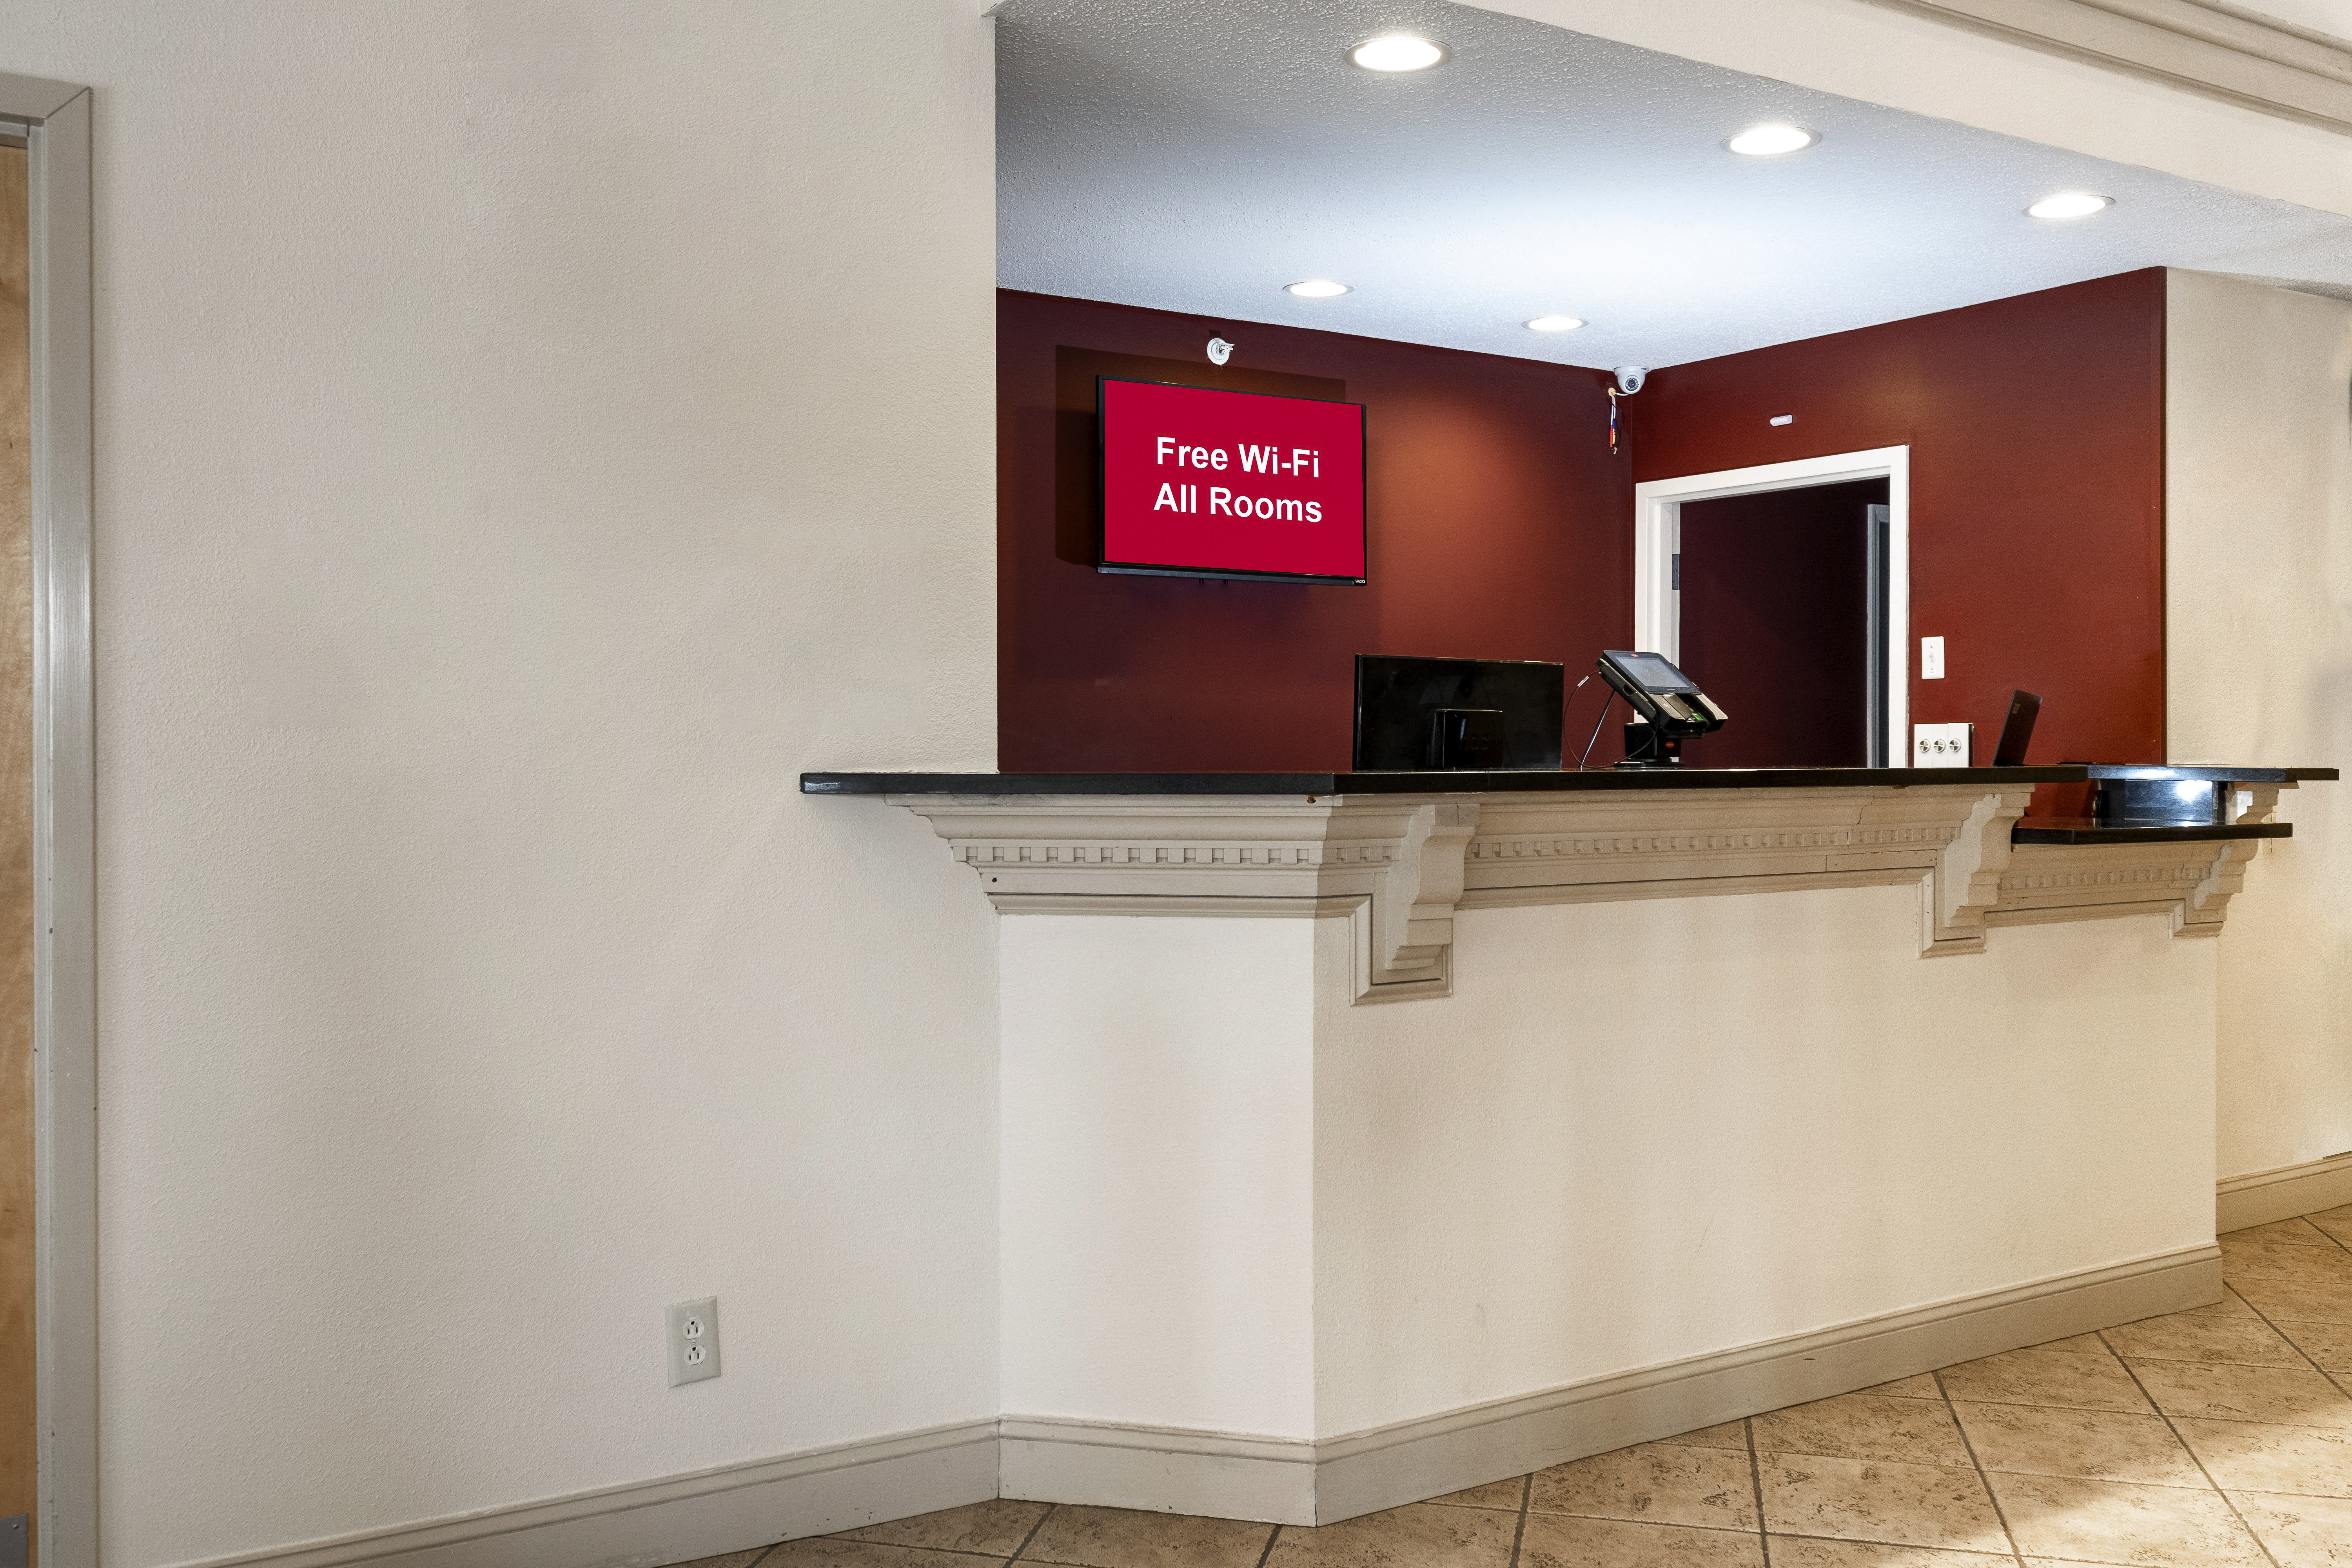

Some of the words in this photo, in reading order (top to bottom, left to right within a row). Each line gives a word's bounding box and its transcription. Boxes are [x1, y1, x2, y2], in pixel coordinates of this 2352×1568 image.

[1157, 436, 1228, 470] Free
[1238, 443, 1319, 478] Wi-Fi
[1153, 483, 1196, 513] All
[1210, 486, 1322, 523] Rooms
